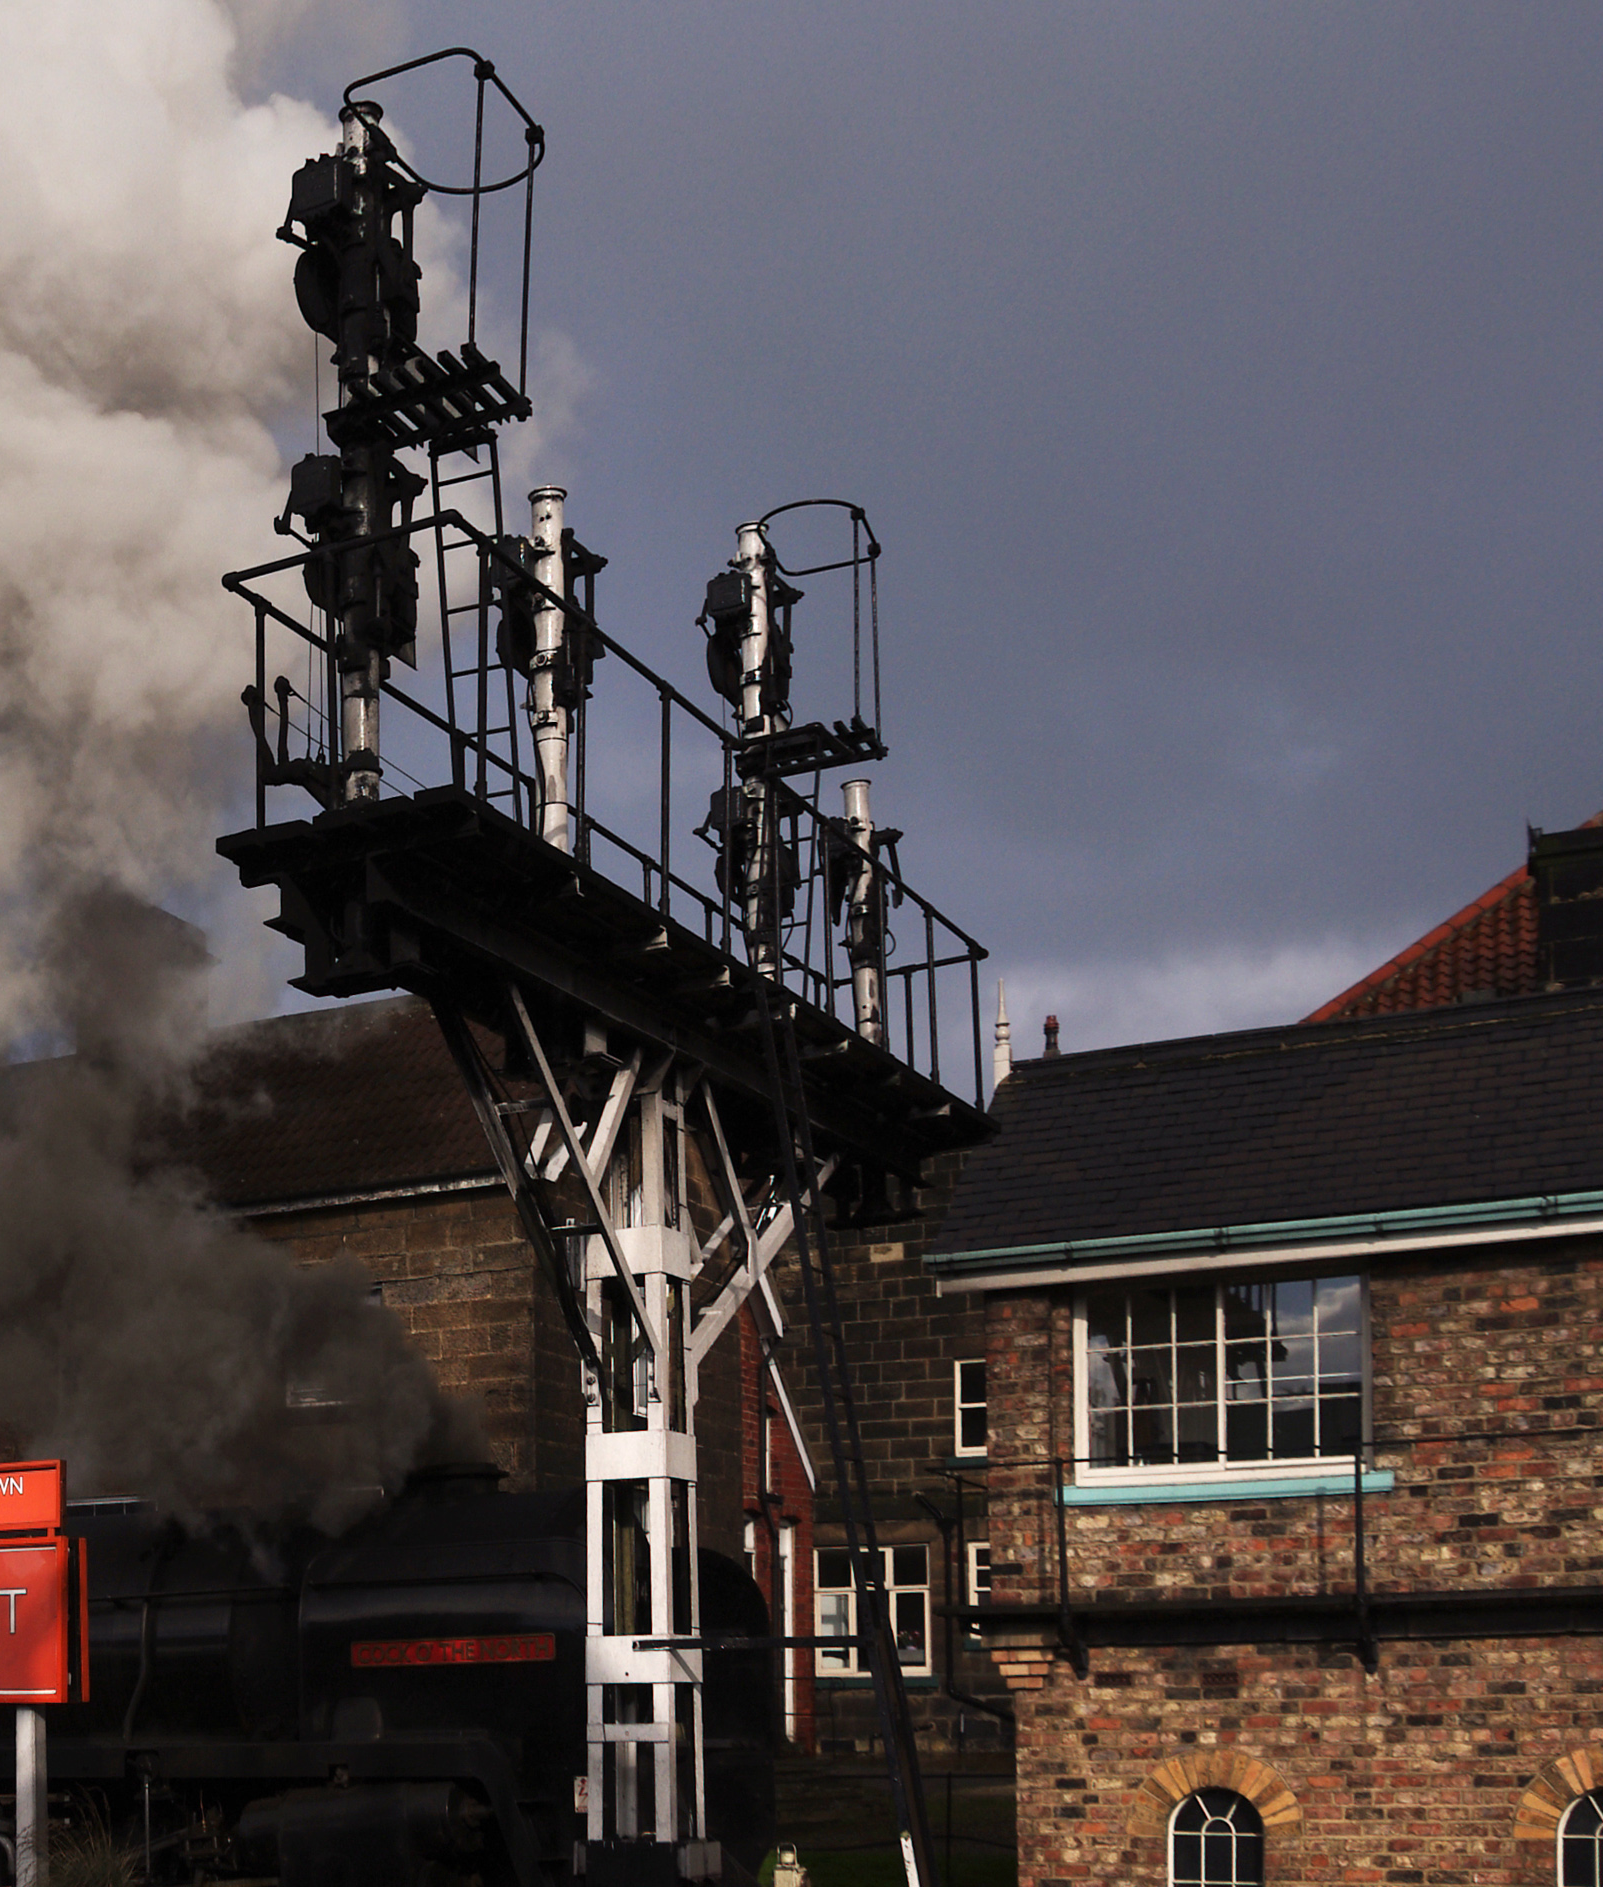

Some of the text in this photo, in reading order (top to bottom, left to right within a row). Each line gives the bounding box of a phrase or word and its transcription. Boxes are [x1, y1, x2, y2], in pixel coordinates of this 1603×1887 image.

[356, 1636, 550, 1664] COCK O' THE NORTH
